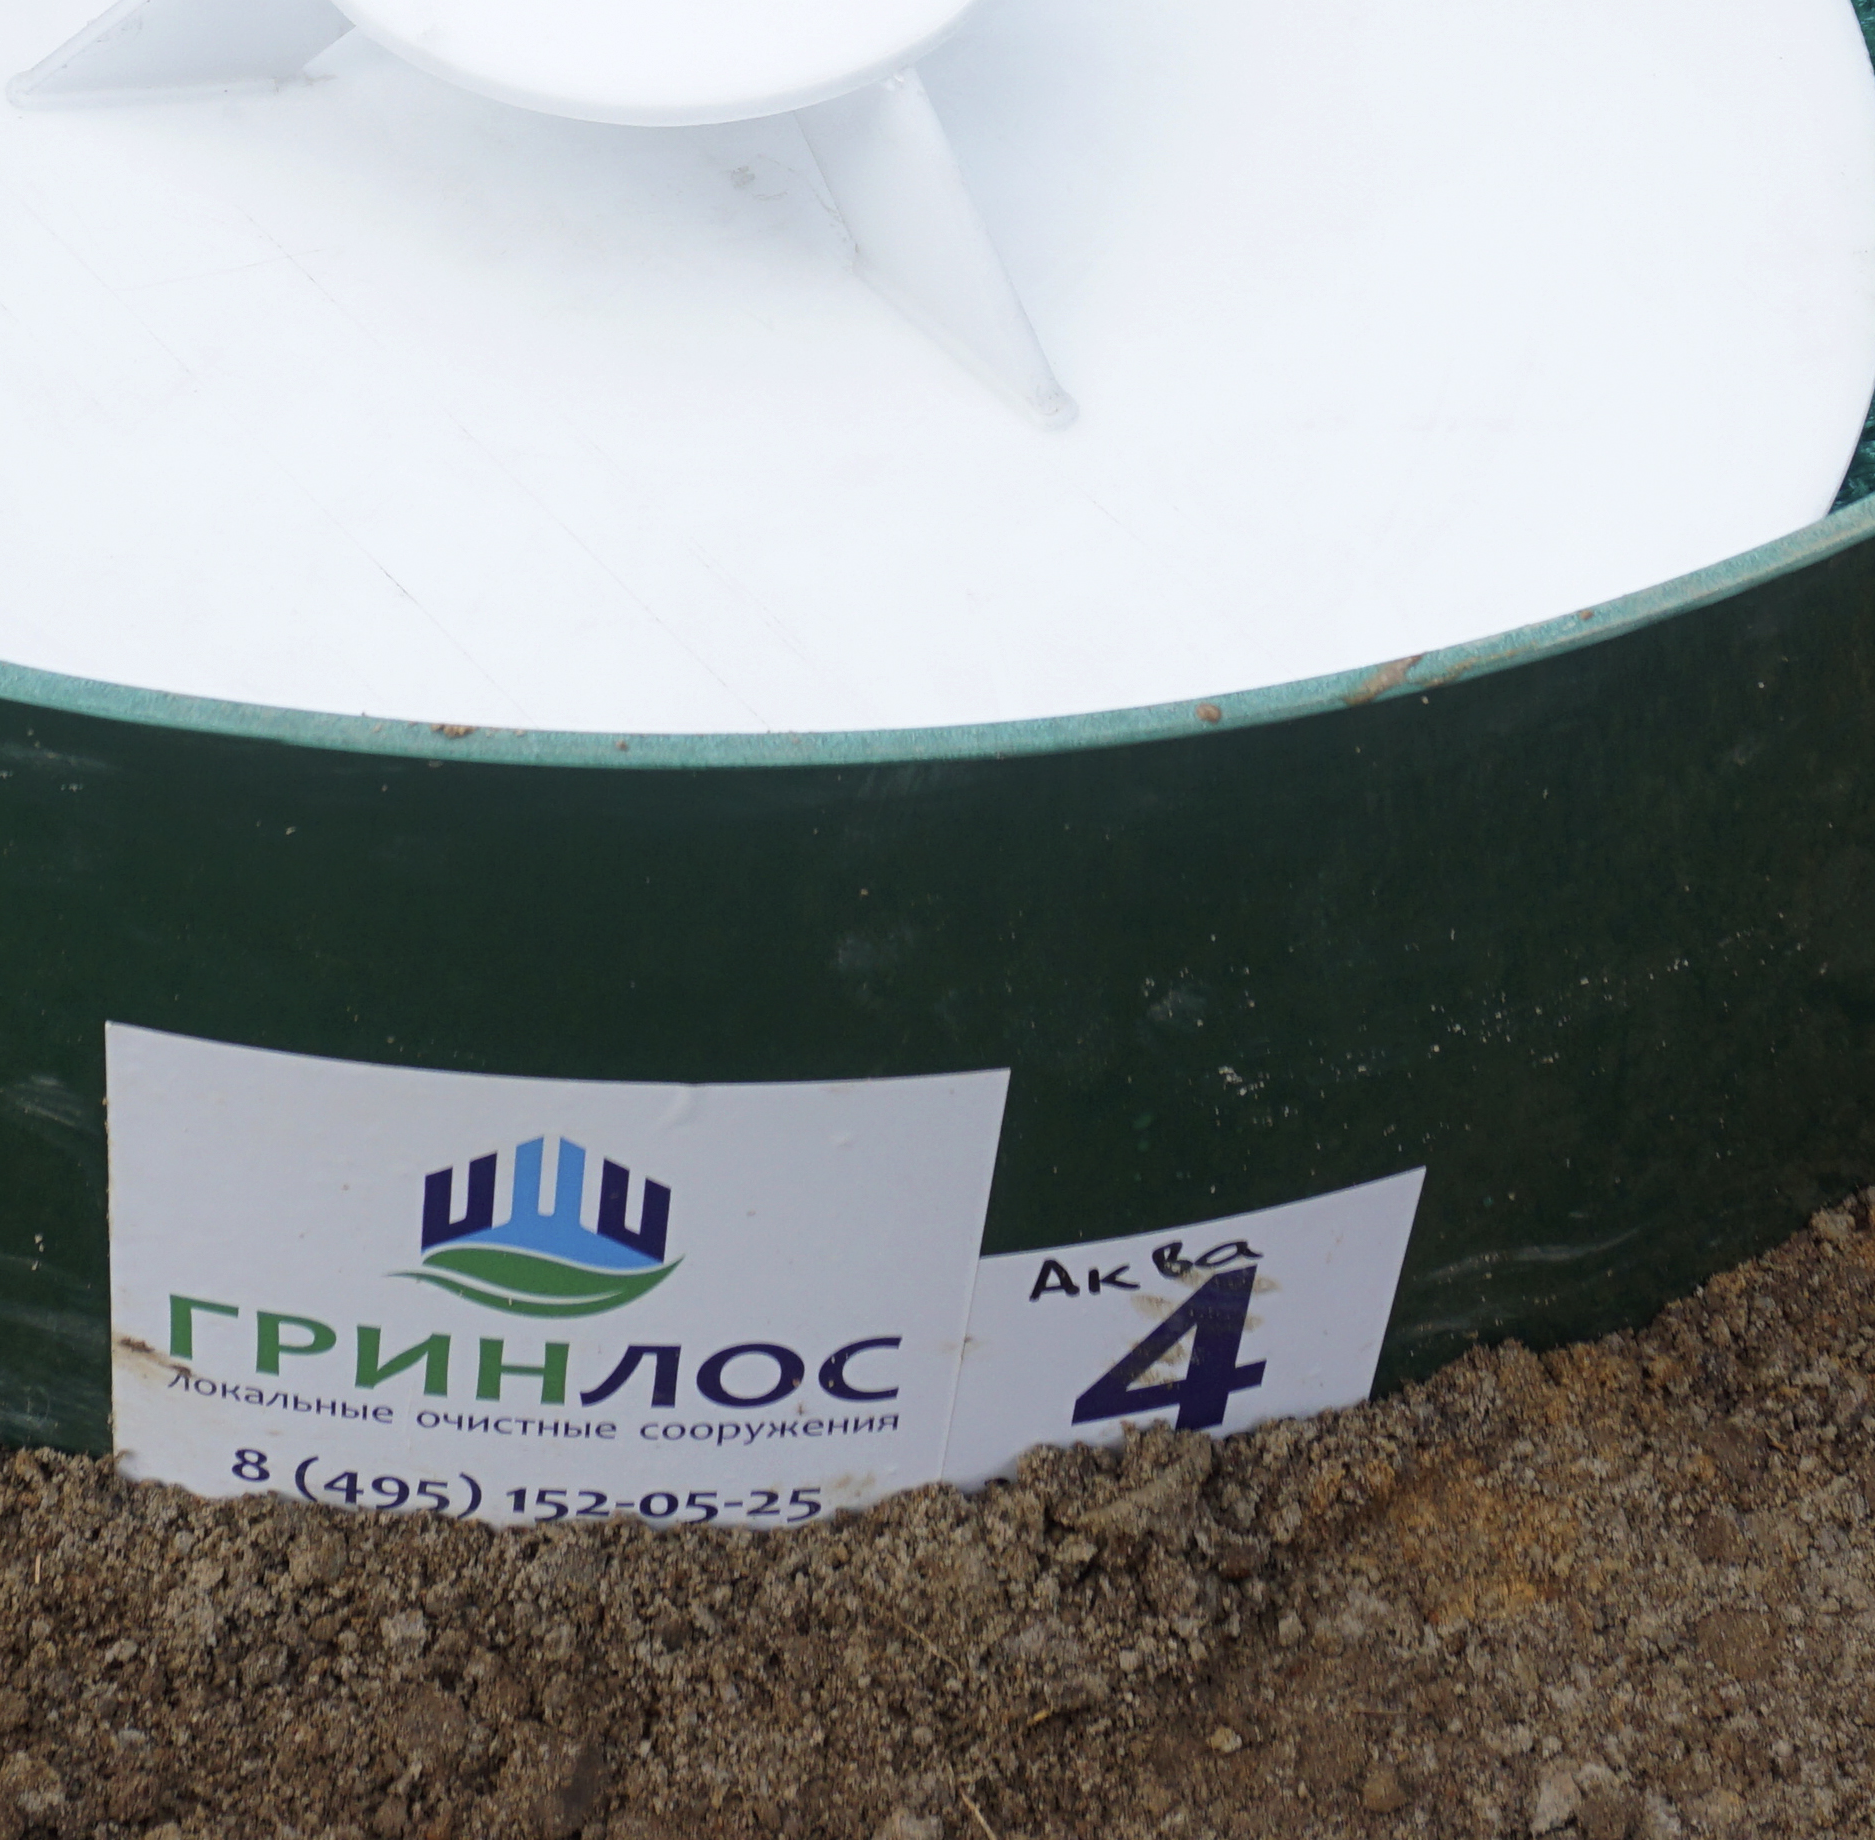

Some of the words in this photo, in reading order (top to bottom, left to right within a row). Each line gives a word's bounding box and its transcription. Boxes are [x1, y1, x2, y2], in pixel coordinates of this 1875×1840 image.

[168, 1294, 903, 1409] ГРИНЛОС
[1071, 1264, 1267, 1431] 4
[416, 1410, 617, 1439] очистные
[639, 1413, 900, 1446] сооружения
[231, 1448, 271, 1482] 8
[294, 1456, 482, 1520] (495)
[506, 1487, 823, 1523] 152-05-25
